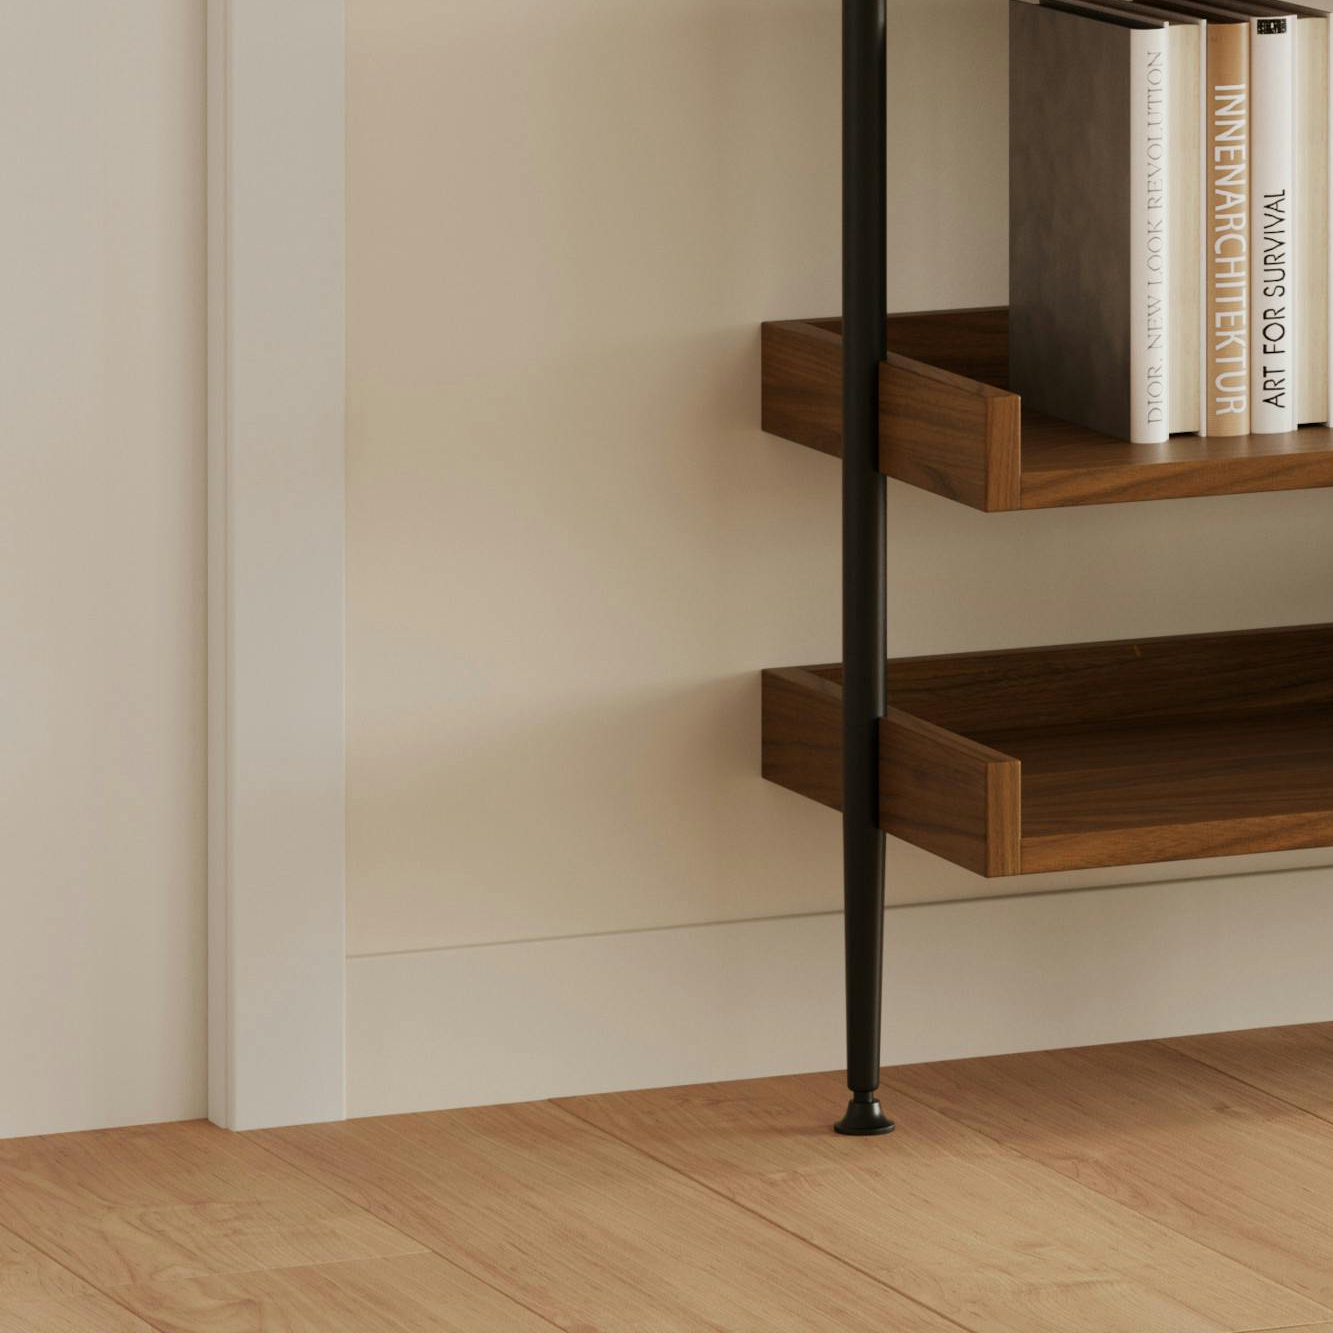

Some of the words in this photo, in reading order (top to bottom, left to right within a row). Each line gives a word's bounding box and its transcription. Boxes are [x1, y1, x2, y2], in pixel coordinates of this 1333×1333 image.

[1146, 50, 1163, 210] REVOLUTION
[1146, 219, 1163, 286] LOOK
[1214, 83, 1248, 415] INNENARCHITEKTUR
[1263, 188, 1286, 298] SURVIVAL
[1146, 294, 1163, 350] NEW
[1262, 307, 1286, 355] FOR
[1146, 358, 1163, 424] DIOR.
[1262, 365, 1286, 409] ART
